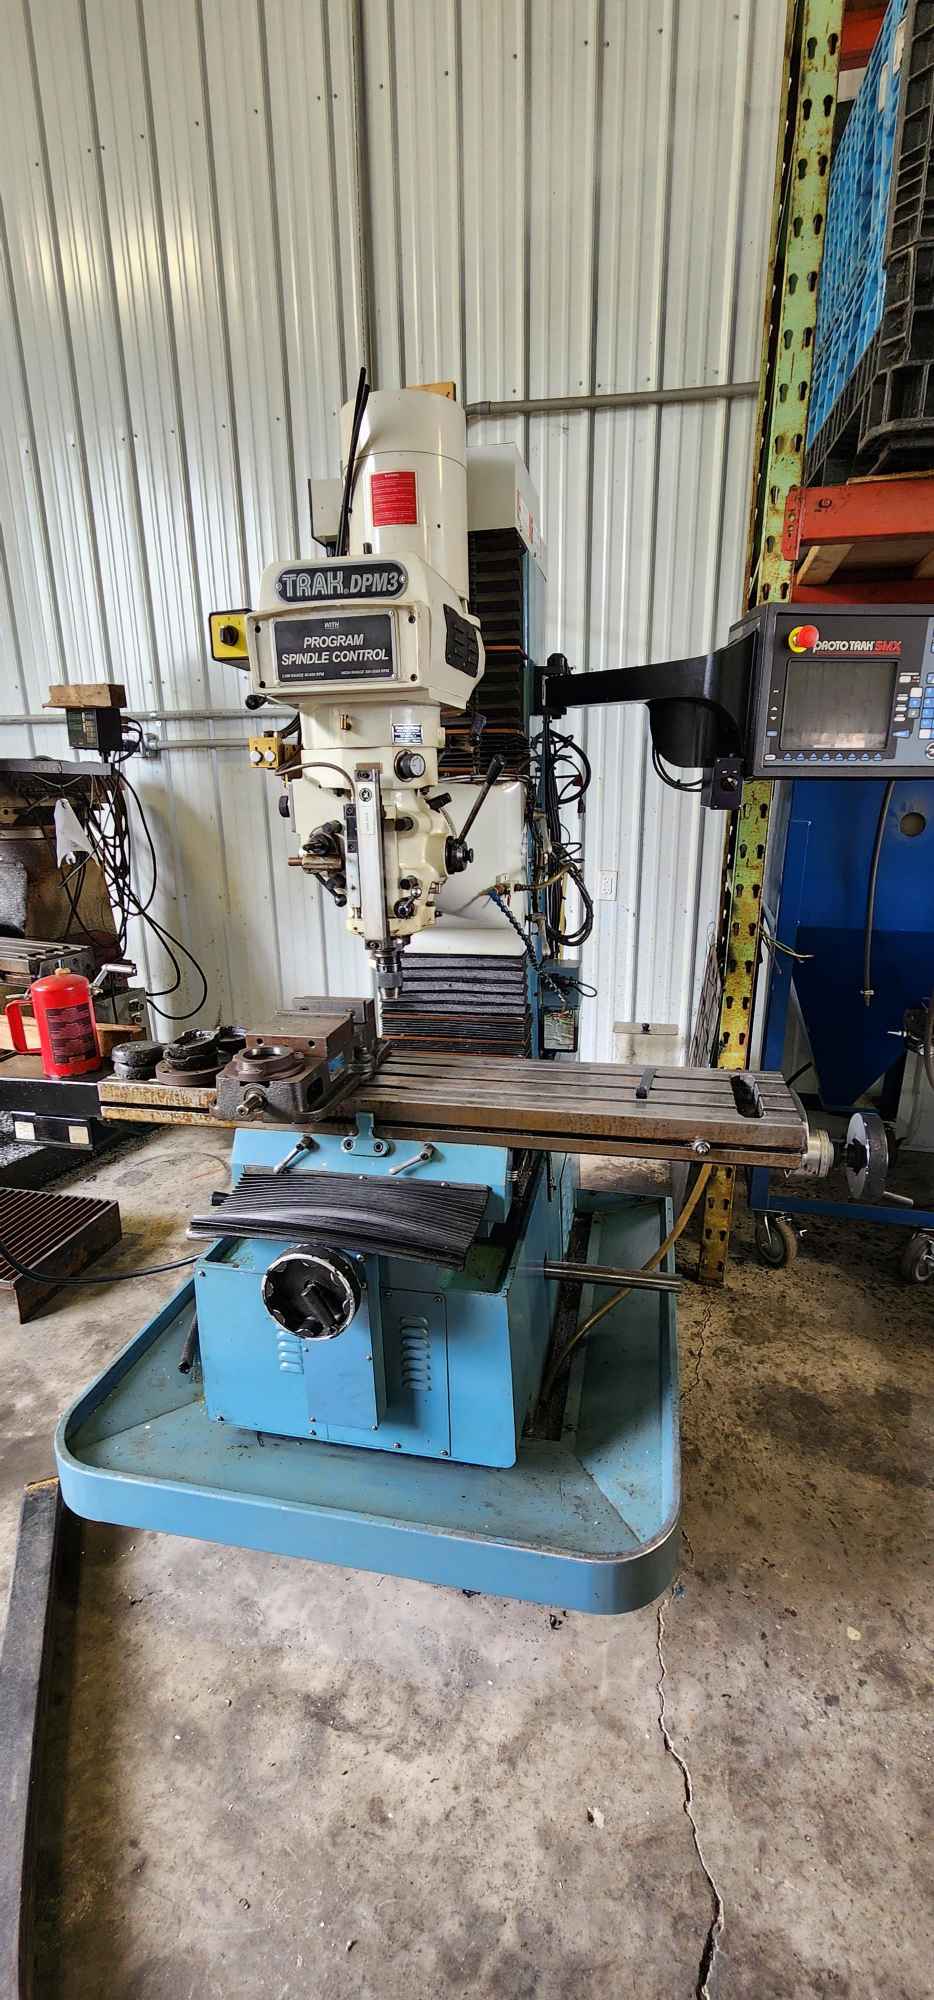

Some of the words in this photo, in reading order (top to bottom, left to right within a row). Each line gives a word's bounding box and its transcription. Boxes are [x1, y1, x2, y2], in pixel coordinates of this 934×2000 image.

[324, 621, 339, 630] WITH
[303, 634, 364, 648] PROGRAM
[875, 640, 902, 651] SMX
[281, 652, 330, 666] SPINDLE
[332, 649, 389, 663] CONTROL
